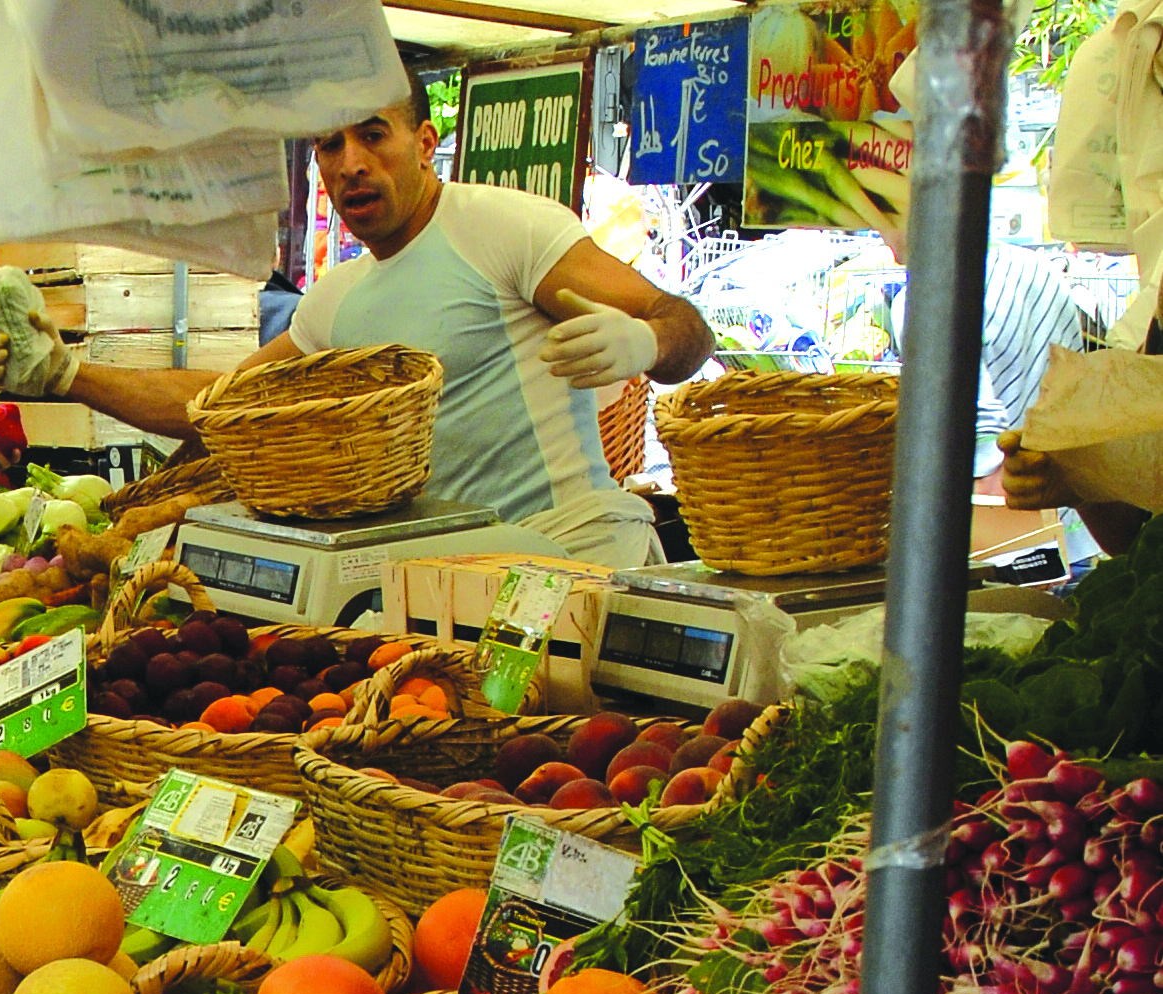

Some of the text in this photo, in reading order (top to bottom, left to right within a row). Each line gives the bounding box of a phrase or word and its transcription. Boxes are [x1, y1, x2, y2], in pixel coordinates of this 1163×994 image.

[827, 9, 866, 38] Les
[757, 56, 858, 109] Produits
[470, 100, 526, 152] PROMO
[532, 95, 573, 147] TOUT
[778, 128, 825, 169] Chez
